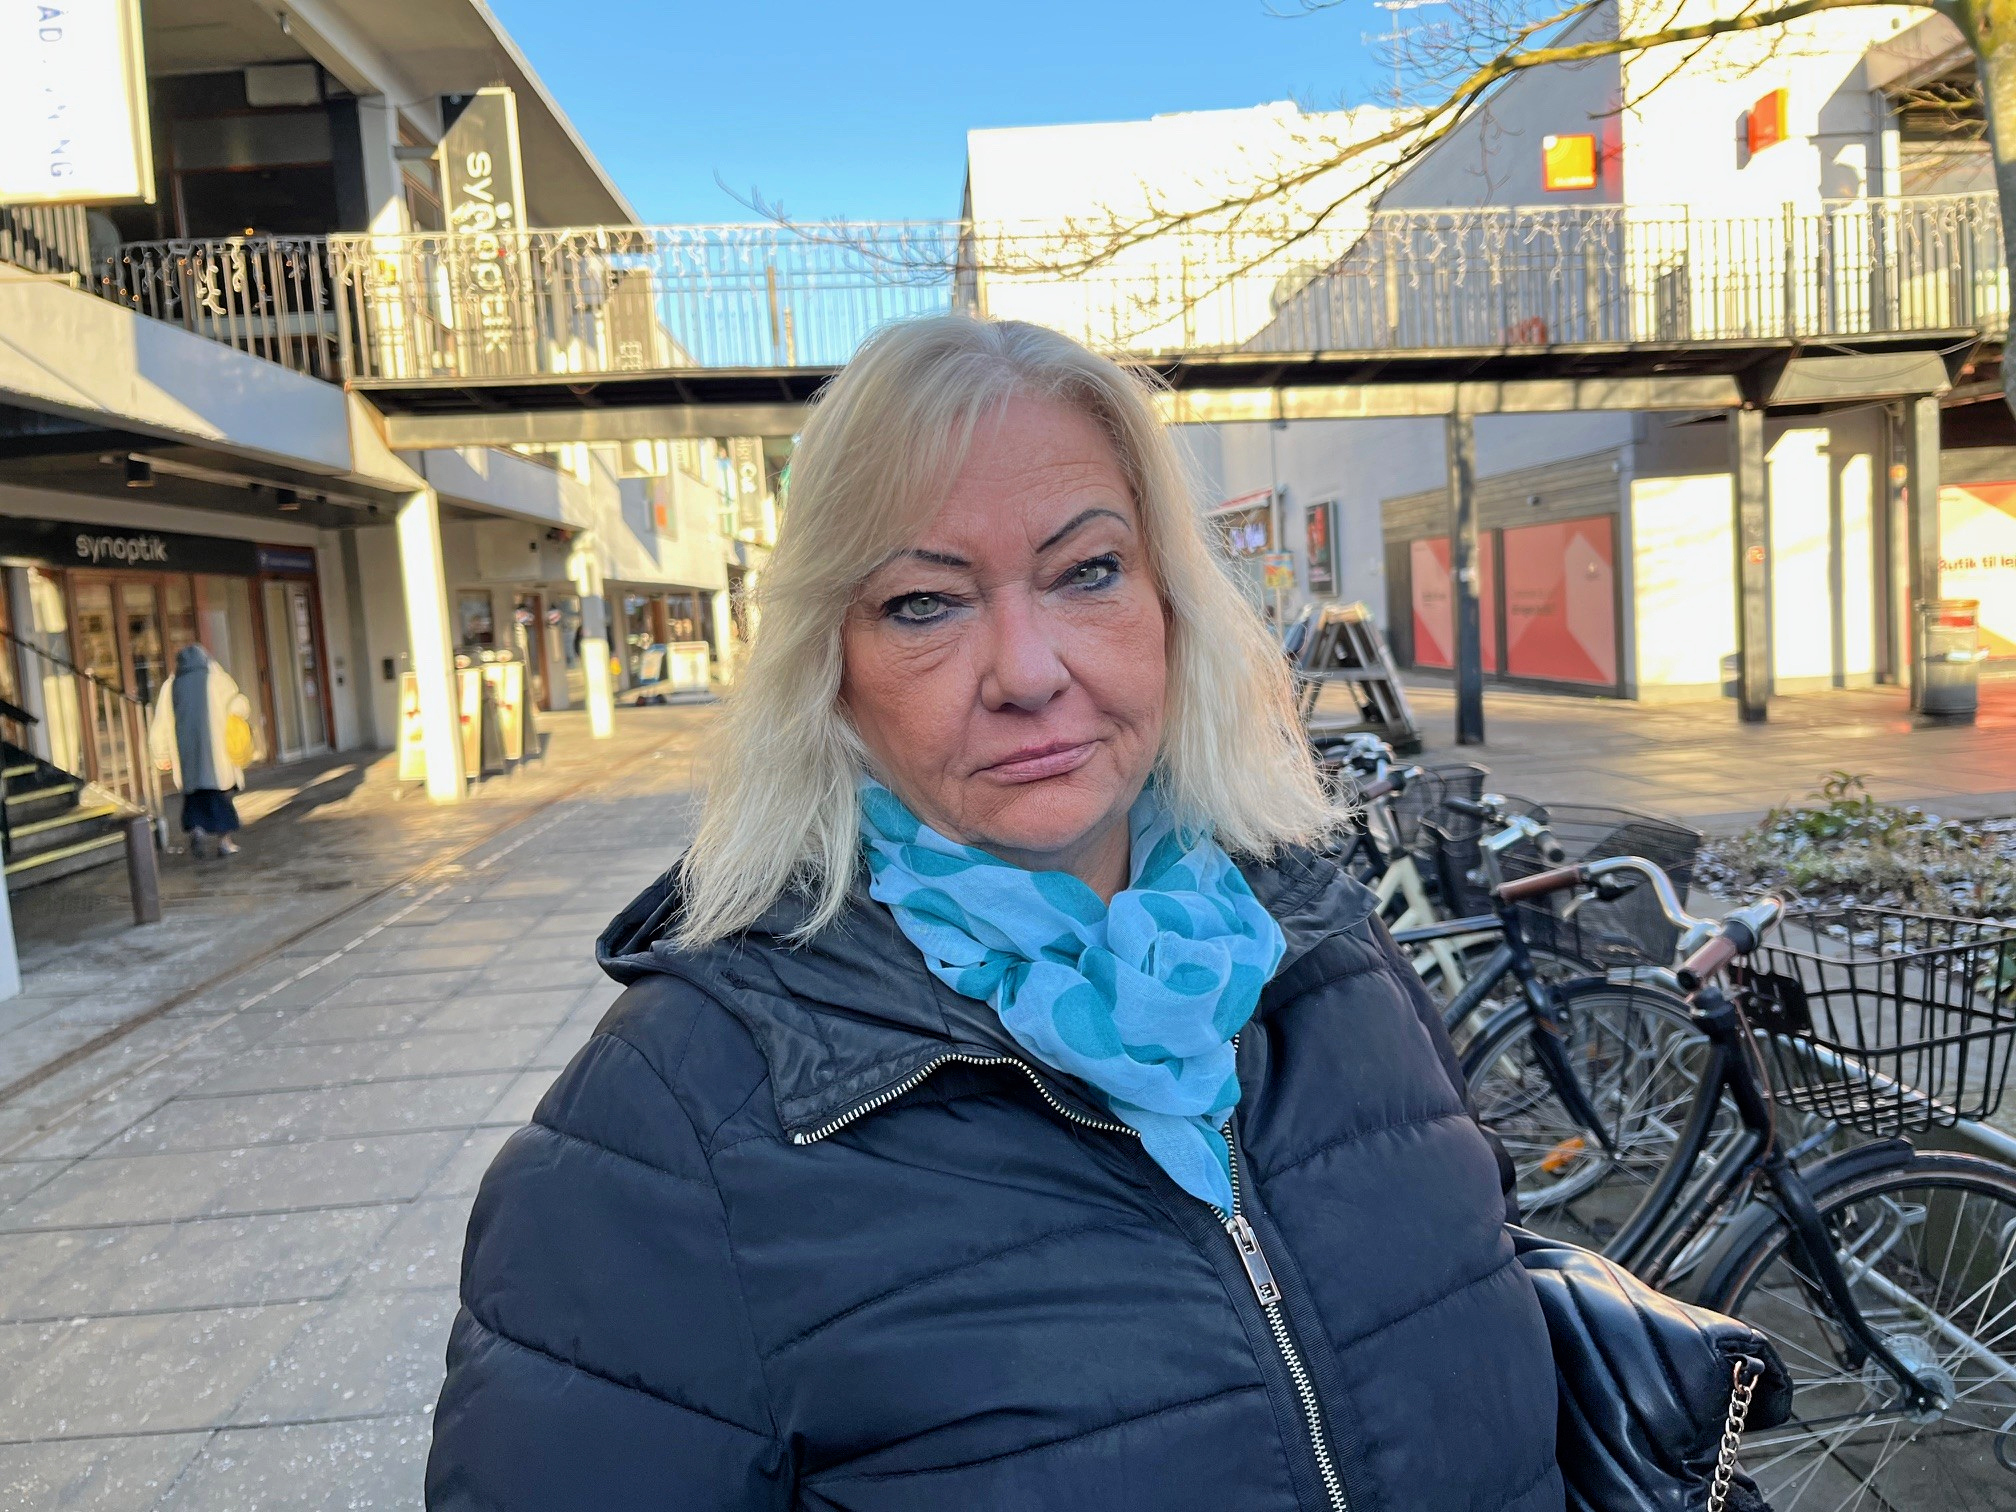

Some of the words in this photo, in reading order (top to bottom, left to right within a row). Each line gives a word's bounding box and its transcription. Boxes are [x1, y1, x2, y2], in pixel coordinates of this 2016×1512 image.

[462, 151, 512, 353] synoptik
[75, 534, 168, 565] synoptik
[1982, 557, 1997, 568] til
